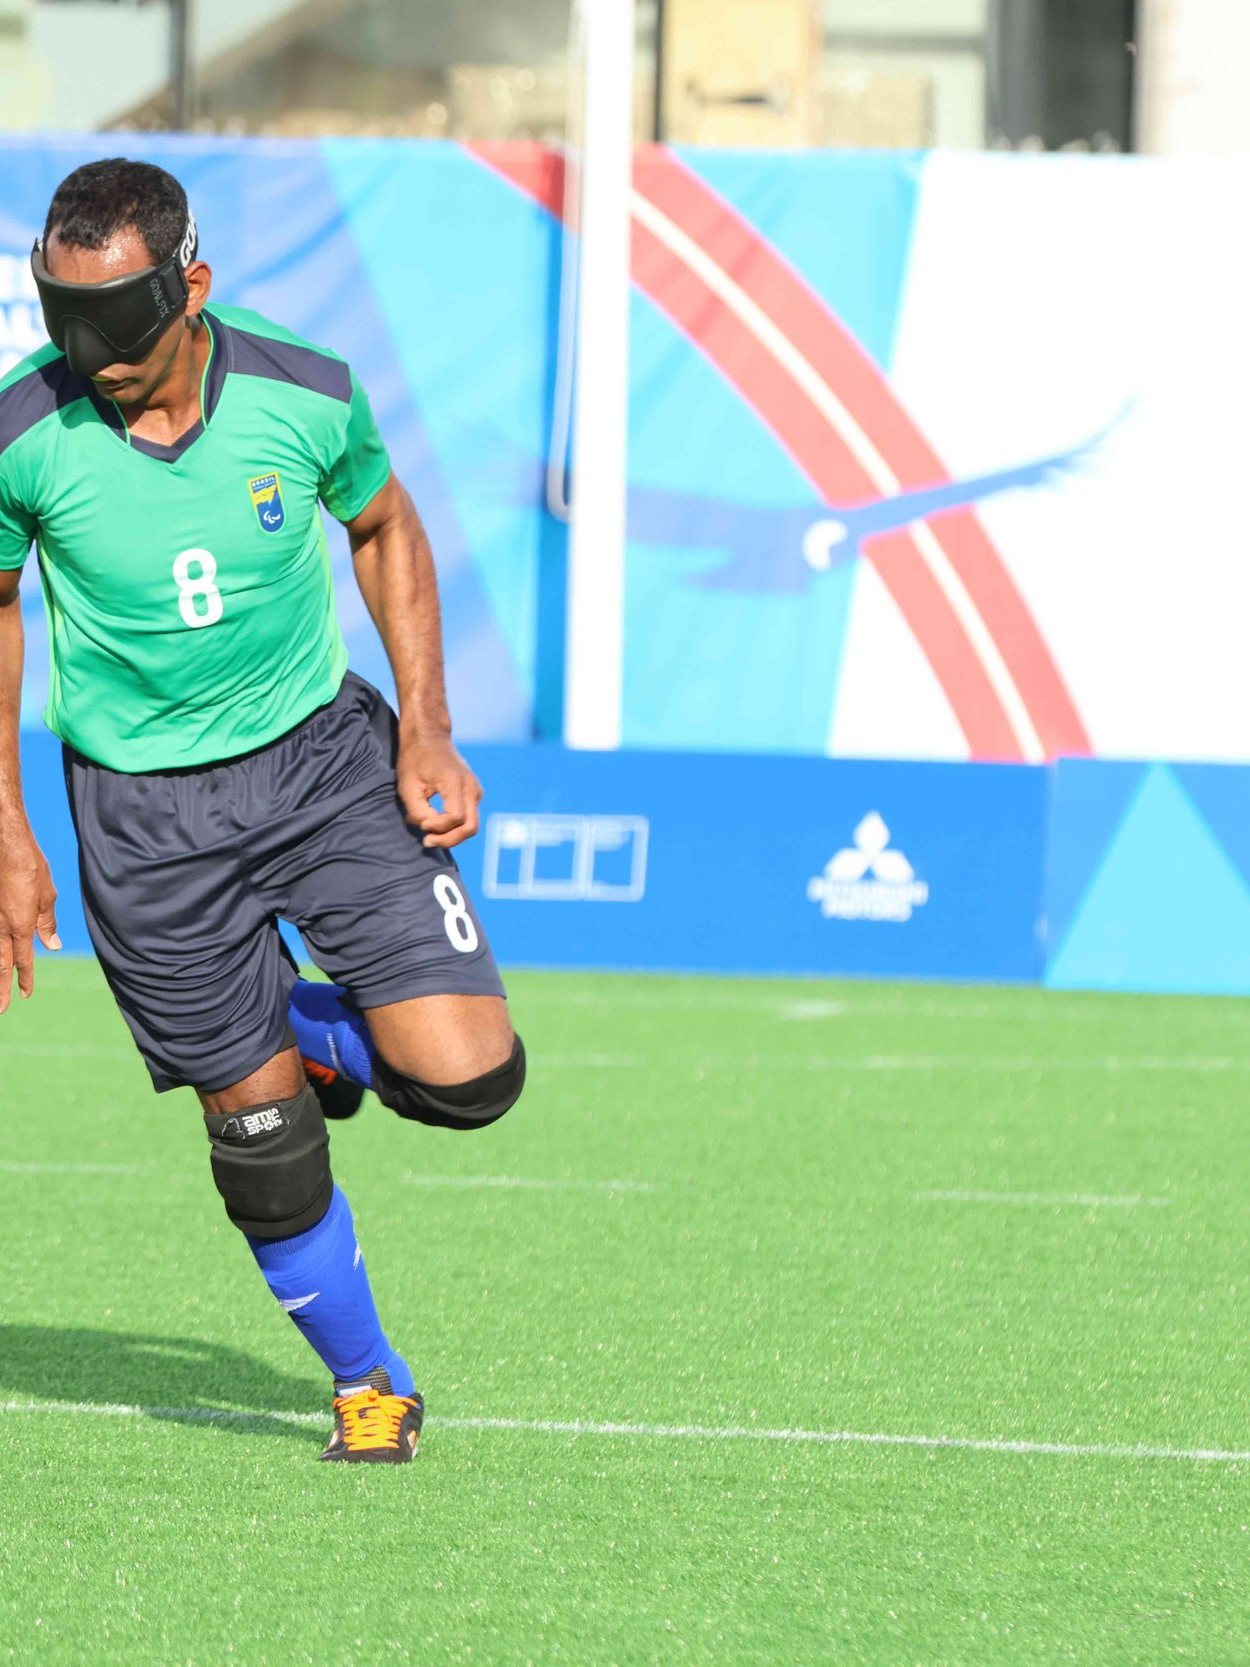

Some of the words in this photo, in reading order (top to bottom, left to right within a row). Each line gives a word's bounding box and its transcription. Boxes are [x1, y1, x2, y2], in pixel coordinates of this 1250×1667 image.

[150, 278, 170, 318] GOALFIX
[172, 547, 223, 628] 8
[433, 874, 478, 953] 8
